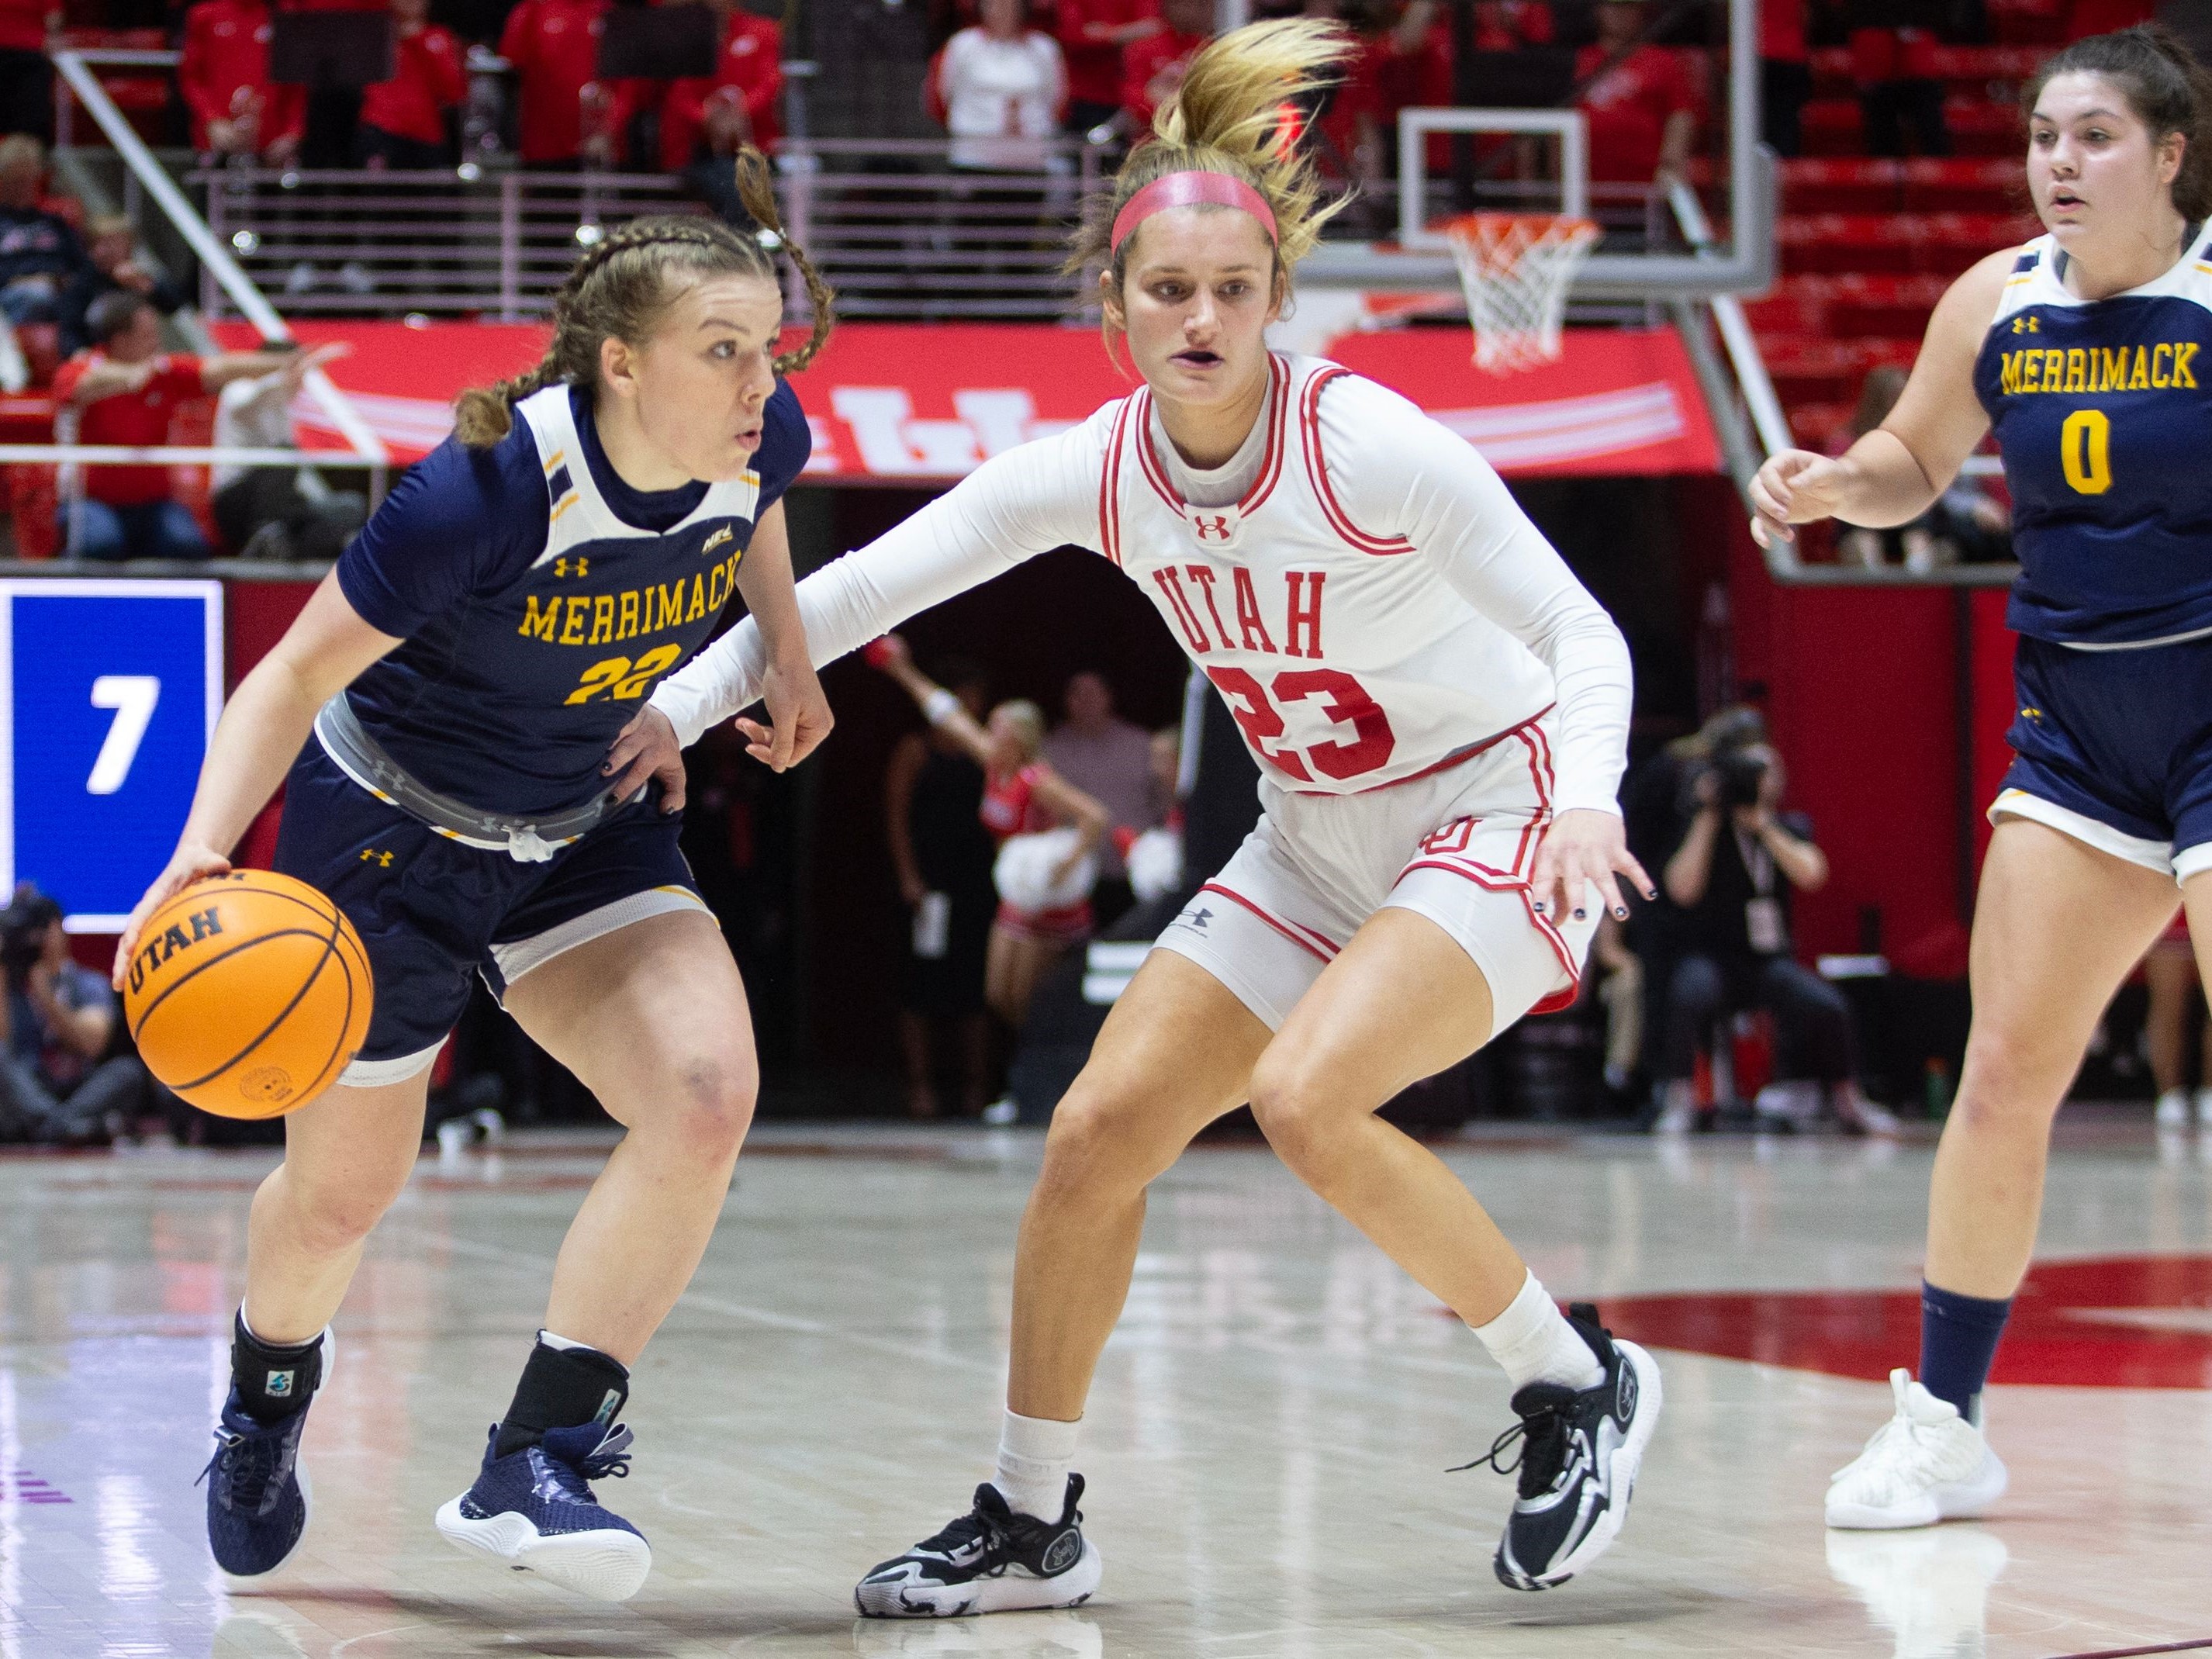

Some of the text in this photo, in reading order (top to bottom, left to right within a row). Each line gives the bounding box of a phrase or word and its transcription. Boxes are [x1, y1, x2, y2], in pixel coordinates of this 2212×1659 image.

[2000, 342, 2200, 395] MERRIMACK
[2061, 410, 2113, 495] 0
[518, 549, 742, 646] MERRIMACK
[1152, 564, 1326, 659] UTAH
[564, 642, 682, 706] 22
[86, 675, 161, 795] 7
[1206, 665, 1396, 783] 23
[129, 906, 223, 995] UTAH
